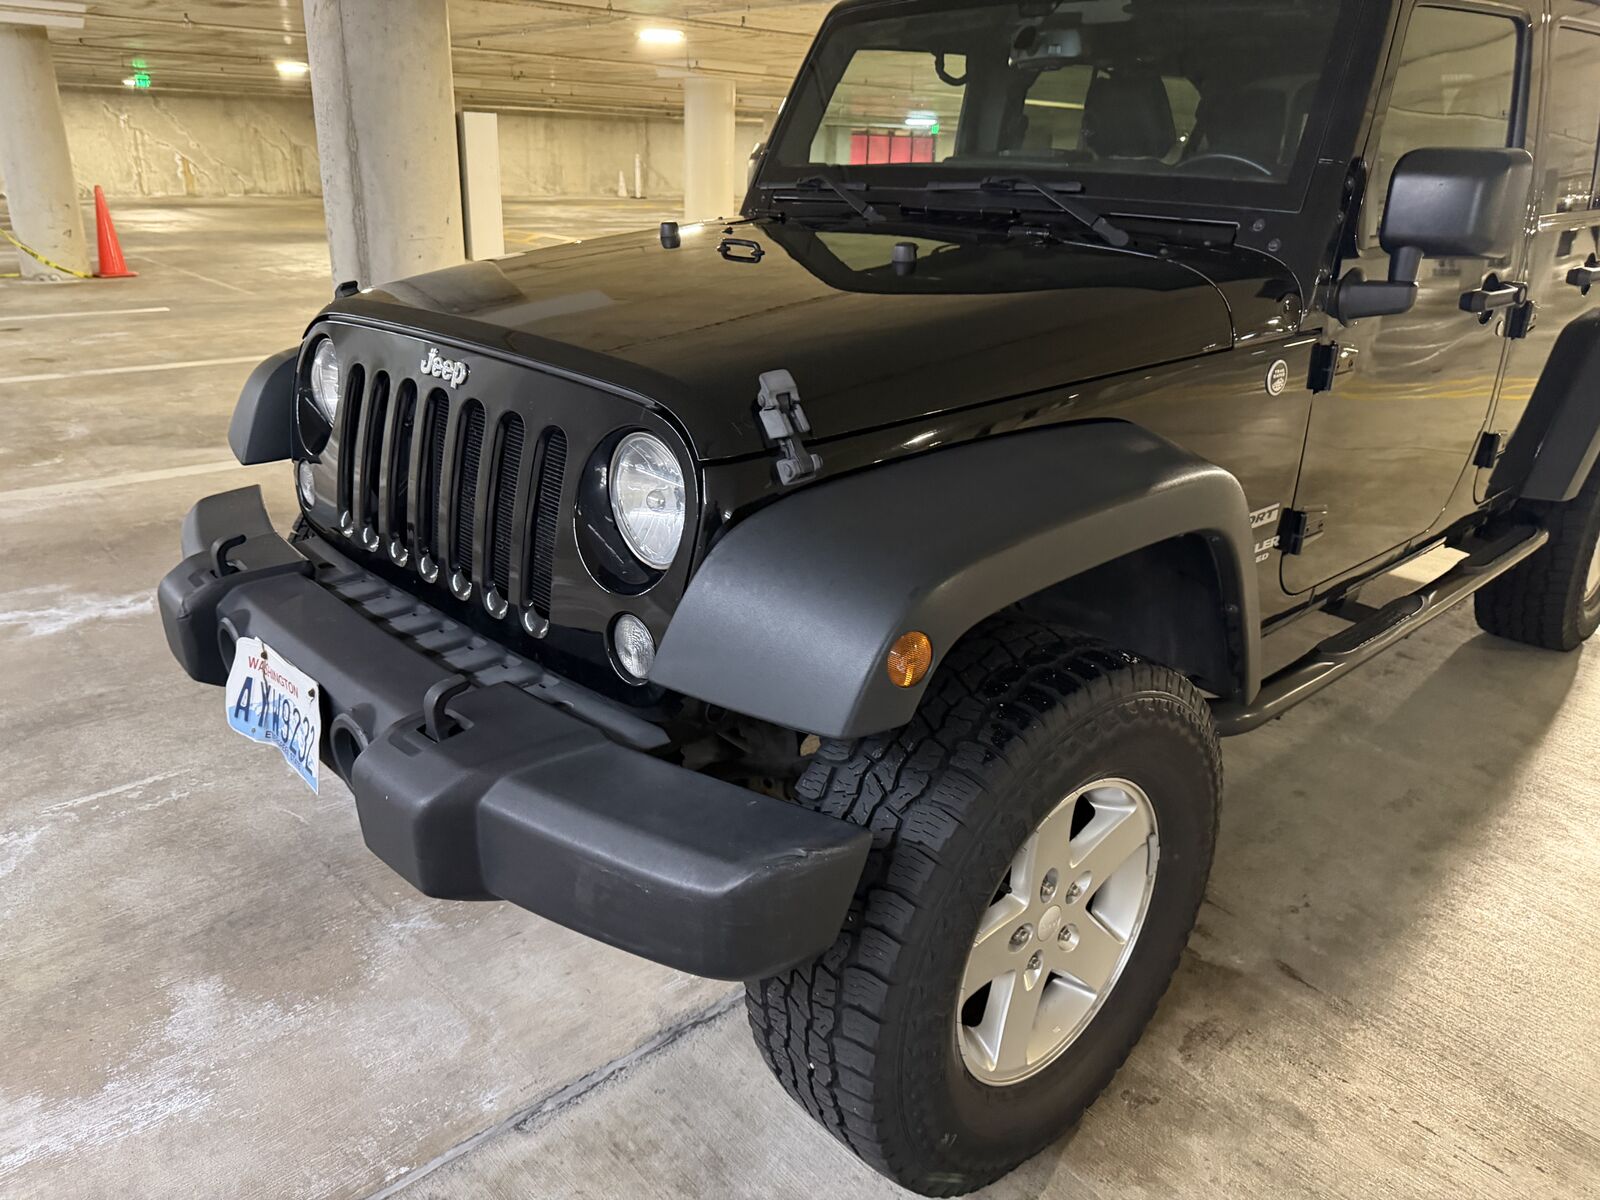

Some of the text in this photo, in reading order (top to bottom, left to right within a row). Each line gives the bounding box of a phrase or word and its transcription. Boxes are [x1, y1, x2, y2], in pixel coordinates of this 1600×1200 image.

[420, 347, 467, 390] Jeep
[248, 655, 299, 699] WASHINGTON
[234, 676, 315, 776] AXW9232
